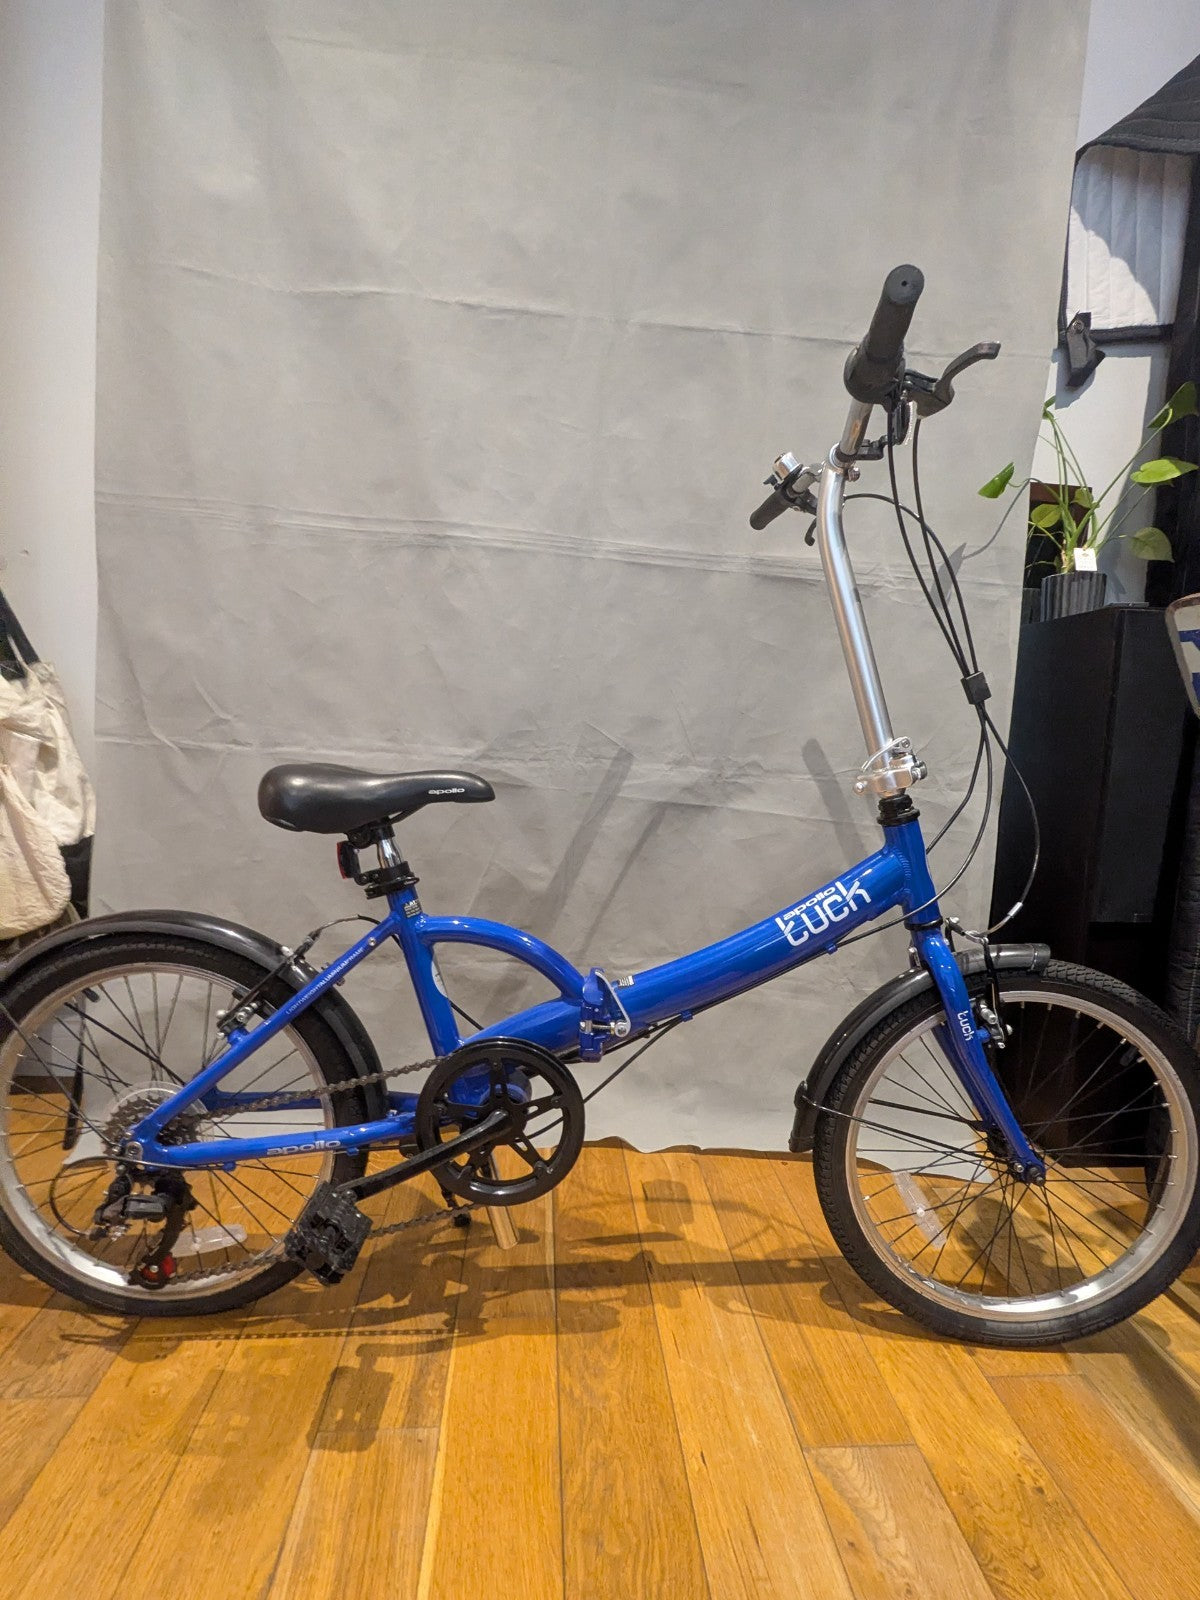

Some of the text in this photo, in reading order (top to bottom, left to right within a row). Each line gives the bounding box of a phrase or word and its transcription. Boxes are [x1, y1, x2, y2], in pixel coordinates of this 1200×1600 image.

[428, 787, 465, 795] apollo
[775, 880, 871, 946] tuck
[783, 886, 836, 920] apollo
[957, 1010, 975, 1041] tuck
[266, 1140, 341, 1155] apollo
